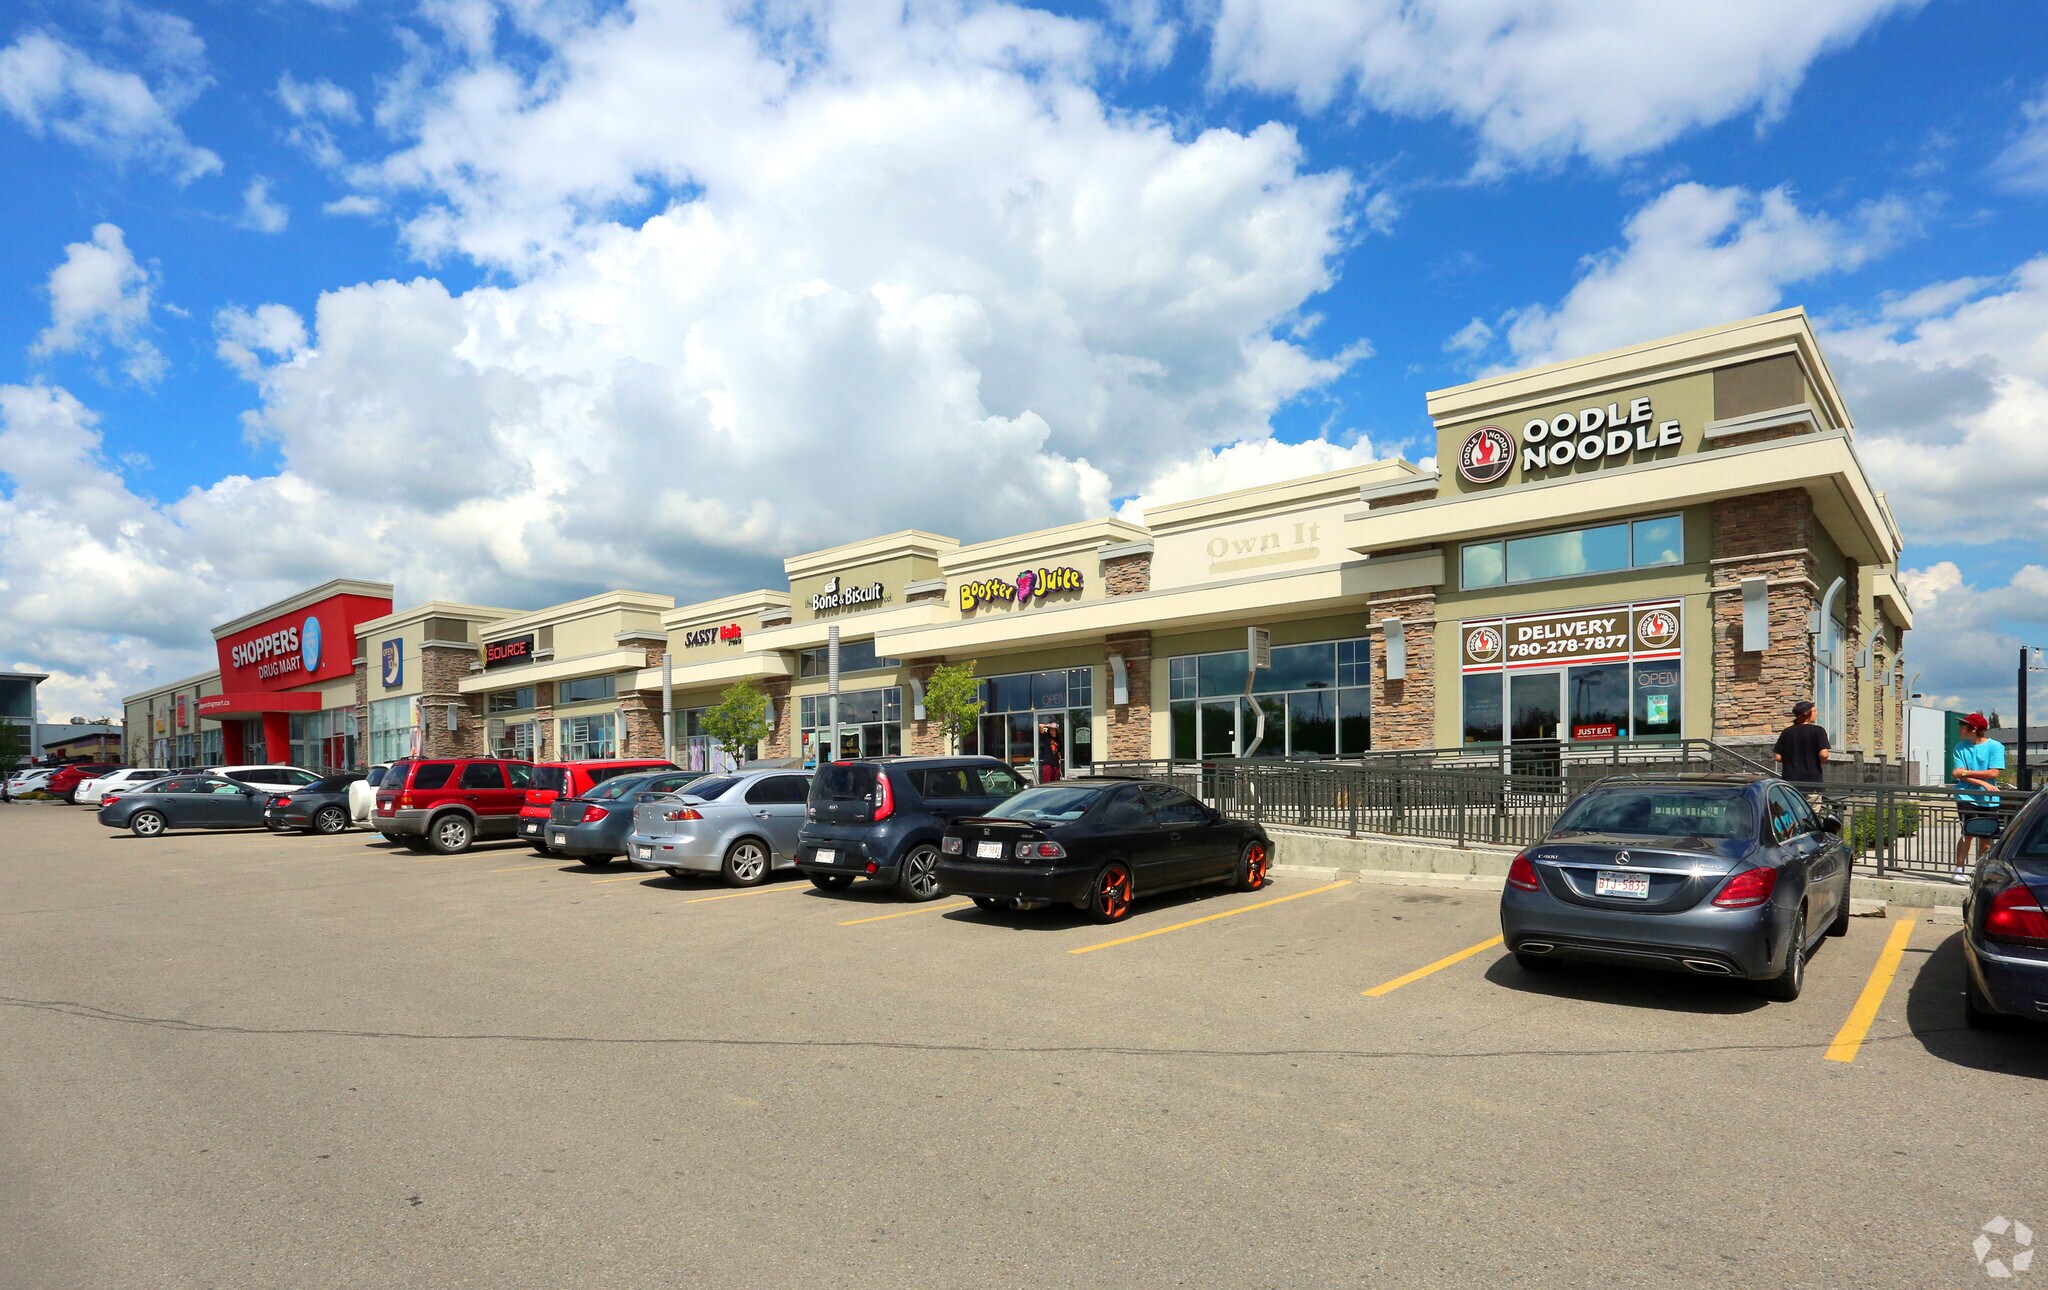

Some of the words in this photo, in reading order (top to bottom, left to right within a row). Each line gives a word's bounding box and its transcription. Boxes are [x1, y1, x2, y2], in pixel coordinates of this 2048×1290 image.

[1523, 396, 1652, 442] OODLE
[1464, 437, 1478, 465] OODLE
[1488, 431, 1508, 459] NOODLE
[1523, 419, 1682, 471] NOODLE
[1206, 532, 1280, 557] Own
[1293, 522, 1320, 544] It
[812, 594, 838, 611] Bone
[839, 594, 845, 604] &
[845, 582, 881, 605] Biscuit
[960, 578, 1015, 611] Booster
[1034, 567, 1081, 597] Juice
[684, 627, 718, 647] SASSY
[720, 623, 742, 640] Nails
[1518, 618, 1616, 641] DELIVERY
[232, 626, 299, 668] SHOPPERS
[488, 641, 527, 661] SOURCE
[1508, 634, 1627, 657] 780-278-7877
[258, 662, 279, 679] DRUG
[279, 655, 301, 673] MART
[1638, 671, 1678, 686] OPEN
[1042, 693, 1066, 705] OPEN
[1577, 728, 1596, 736] JUST
[1597, 726, 1612, 734] EAT
[1598, 877, 1646, 891] BTJ-5835
